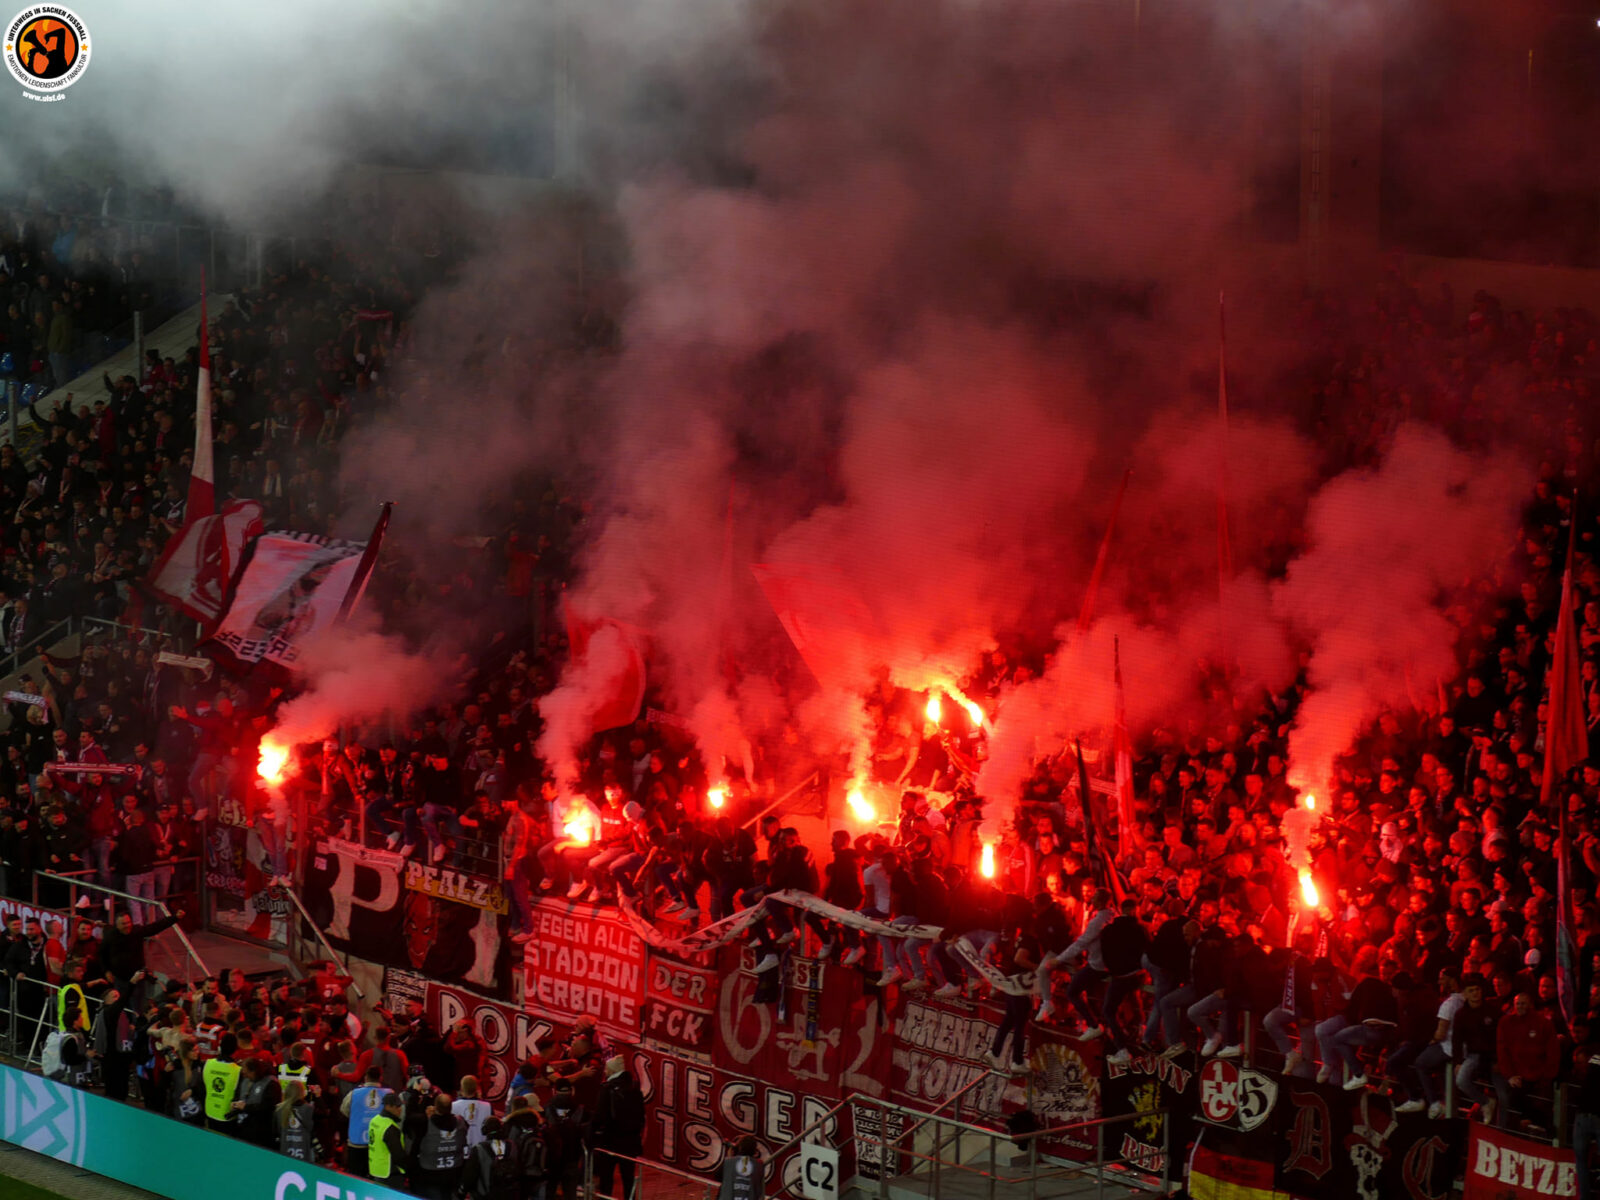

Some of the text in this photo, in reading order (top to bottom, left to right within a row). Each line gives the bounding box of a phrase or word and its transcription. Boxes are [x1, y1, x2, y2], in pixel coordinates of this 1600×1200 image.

[406, 860, 488, 906] PFALZ
[594, 924, 641, 958] ALLE
[524, 938, 639, 993] STADION
[653, 964, 707, 1004] DER
[650, 1003, 704, 1045] FCK
[806, 1157, 834, 1192] C2
[1474, 1138, 1577, 1197] BETZE
